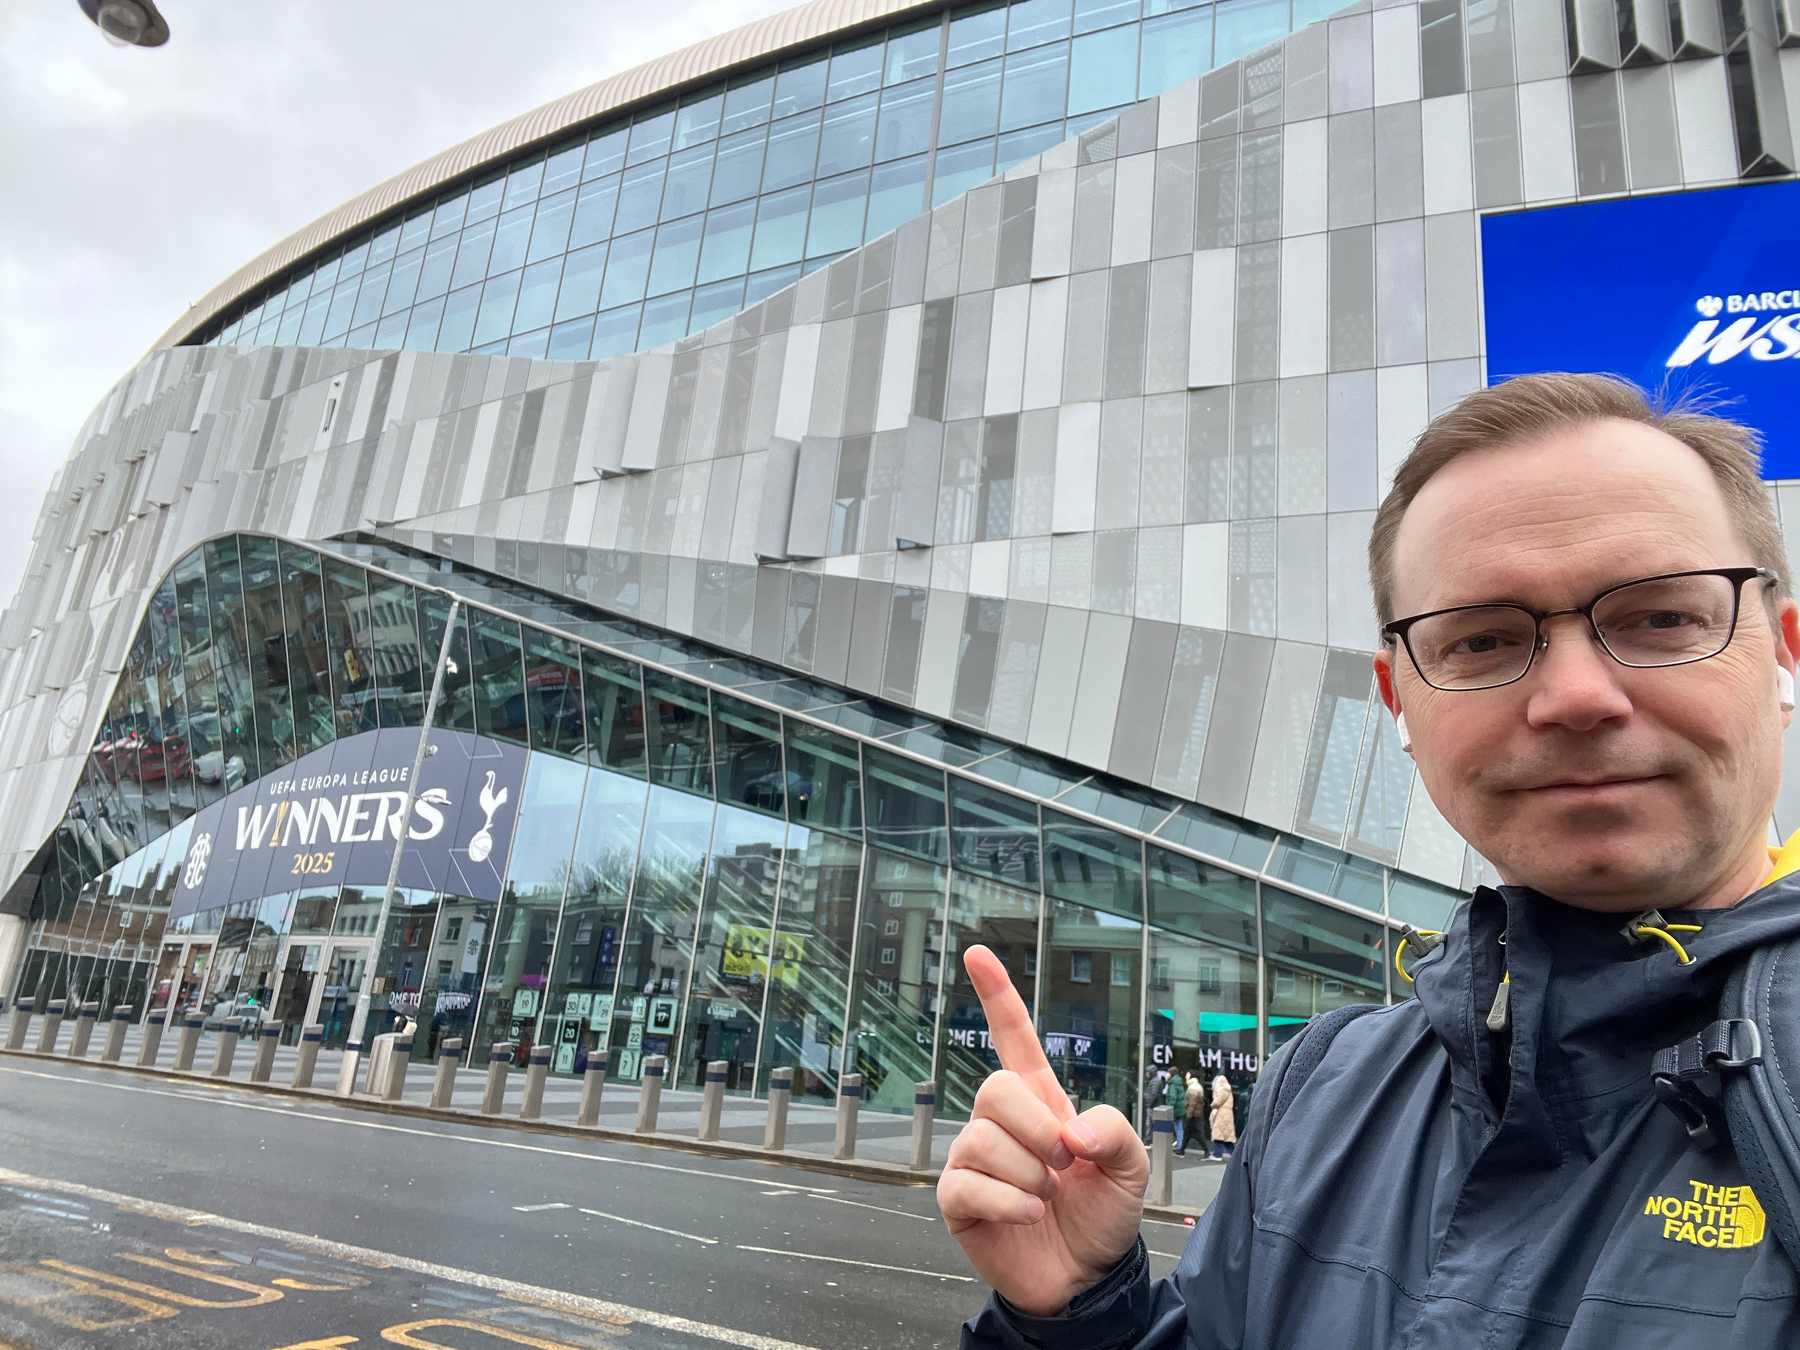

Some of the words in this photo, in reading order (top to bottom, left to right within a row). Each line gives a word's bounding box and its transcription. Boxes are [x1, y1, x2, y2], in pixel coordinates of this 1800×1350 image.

[270, 780, 296, 795] UEFA
[300, 773, 347, 791] EUROPA
[353, 766, 409, 787] LEAGUE
[235, 788, 452, 851] WINNERS
[290, 851, 336, 875] 2025
[564, 1028, 575, 1039] 20
[630, 1033, 640, 1043] 22
[1689, 1179, 1741, 1206] THE
[1644, 1195, 1738, 1227] NORTH
[1662, 1218, 1735, 1248] FACE
